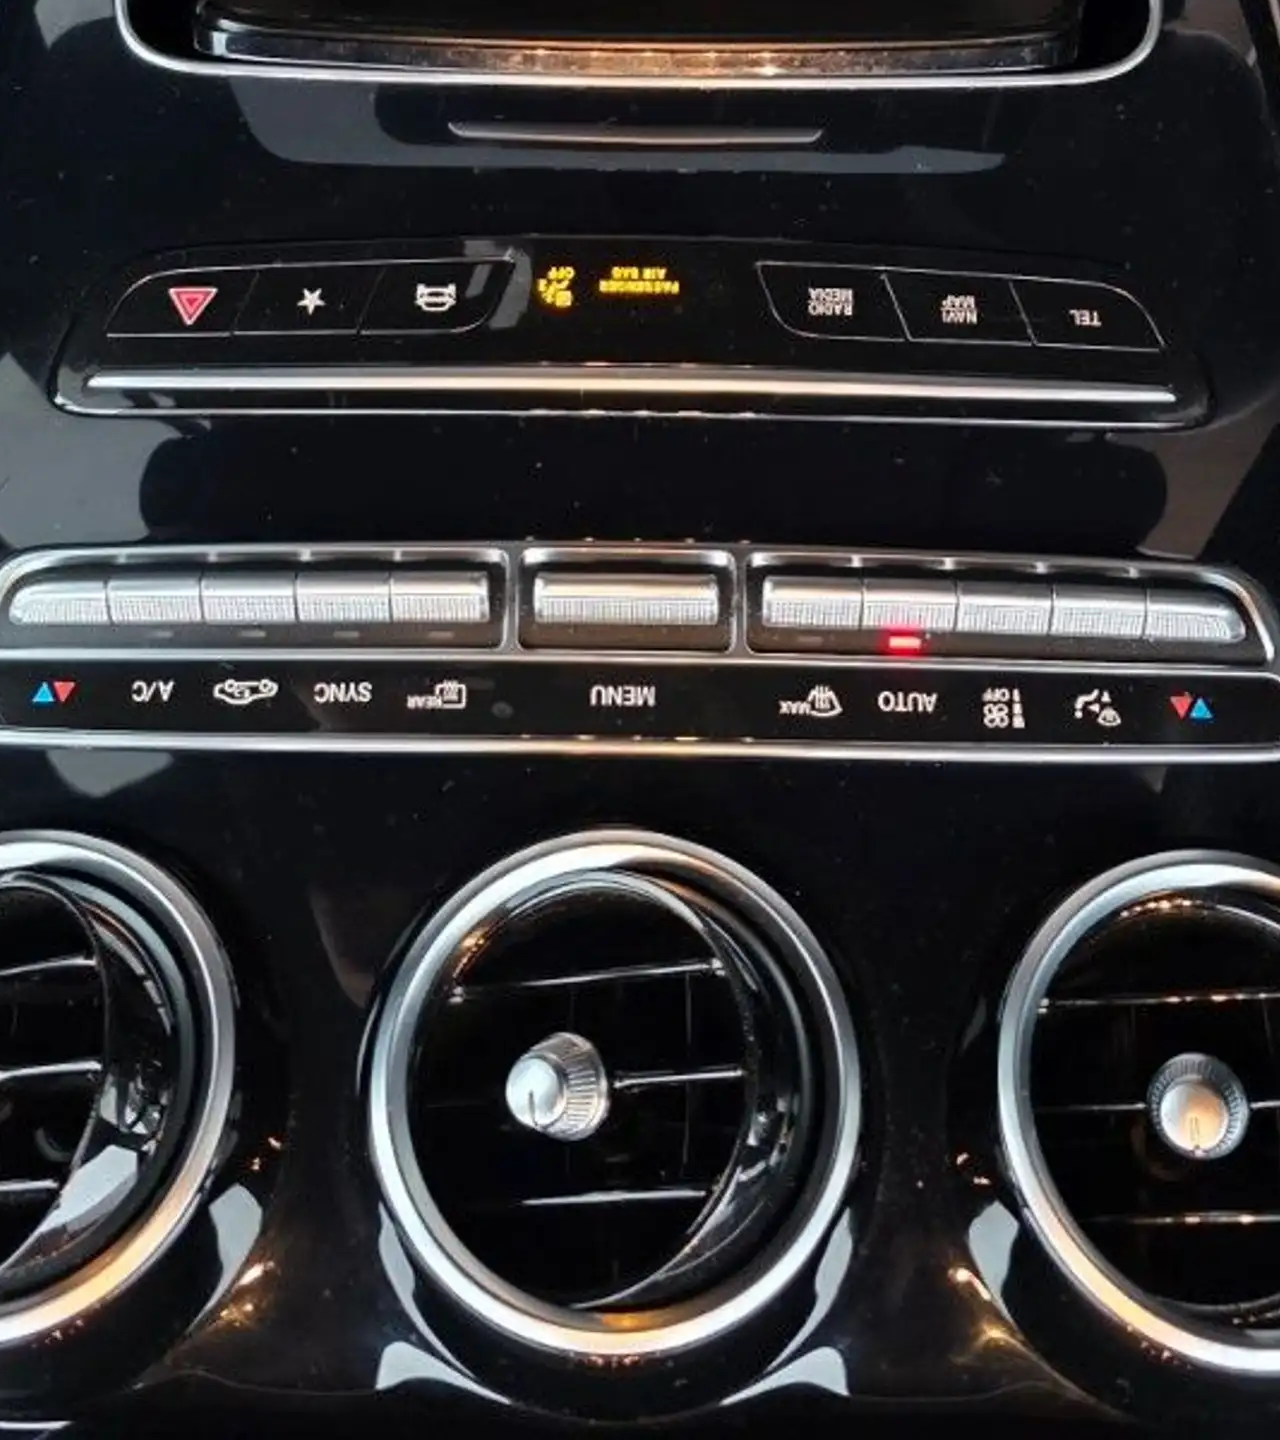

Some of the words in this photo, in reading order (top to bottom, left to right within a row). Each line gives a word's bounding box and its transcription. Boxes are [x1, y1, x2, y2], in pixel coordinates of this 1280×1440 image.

[610, 266, 640, 280] BAG
[641, 267, 667, 280] AIR
[808, 287, 853, 302] MEDIA
[941, 295, 975, 309] MAP
[808, 301, 853, 316] RADIO
[941, 309, 978, 324] NAVI
[1069, 309, 1102, 327] TEL
[132, 680, 174, 702] A/C
[314, 681, 373, 704] SYNC
[590, 684, 656, 707] MENU
[406, 692, 442, 709] REAR
[778, 699, 810, 716] MAX
[877, 690, 938, 713] AUTO
